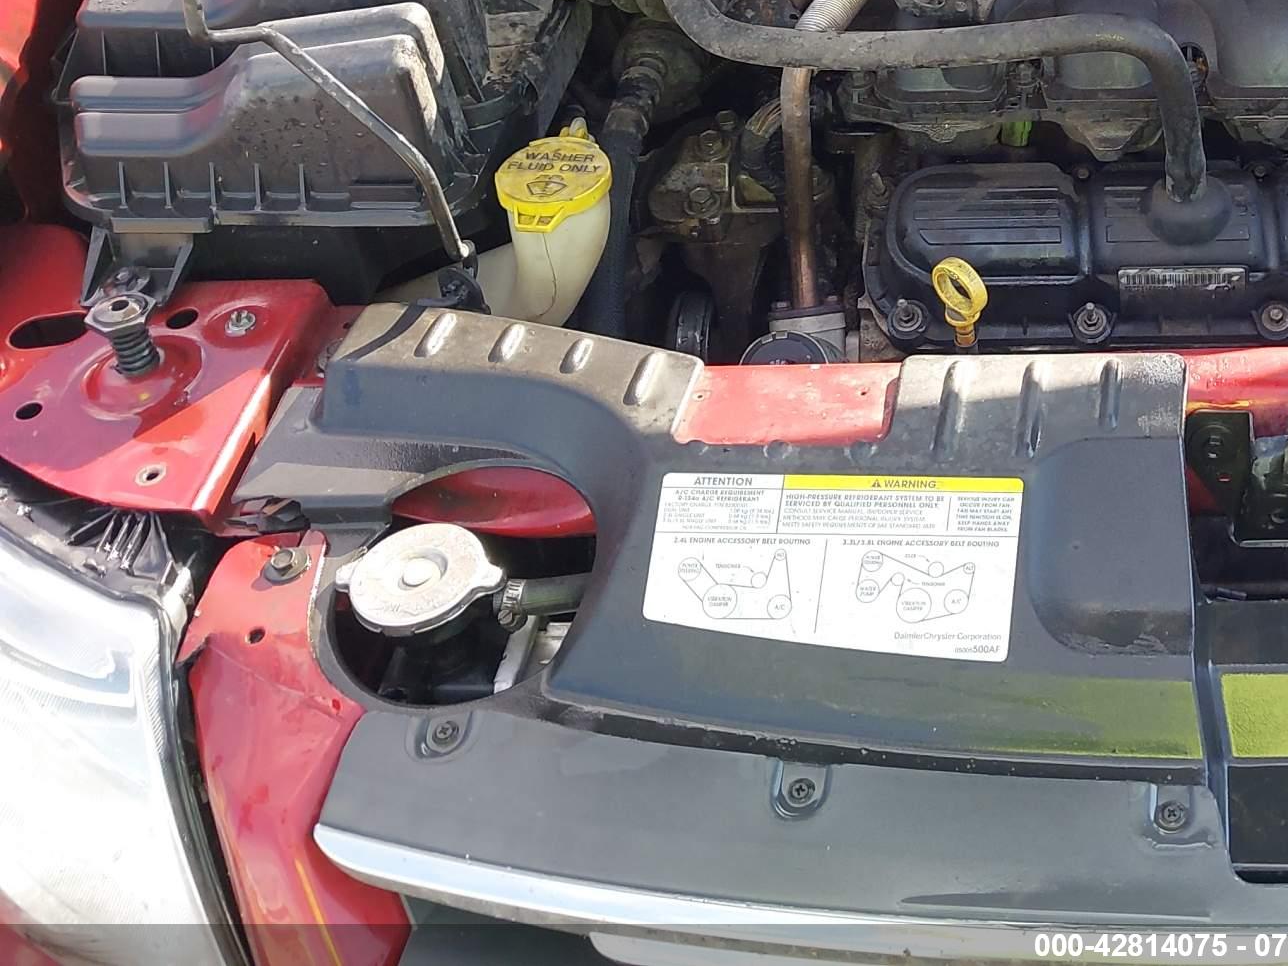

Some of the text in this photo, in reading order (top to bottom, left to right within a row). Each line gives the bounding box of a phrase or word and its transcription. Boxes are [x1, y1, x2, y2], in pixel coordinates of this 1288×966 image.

[525, 152, 595, 163] WASHER
[507, 161, 602, 173] FLUID ONLY
[694, 476, 753, 486] ATTENTION
[884, 480, 937, 488] WARNING
[717, 537, 759, 545] ACCESSORY
[894, 632, 1002, 642] DaimlerChrysler Corporation
